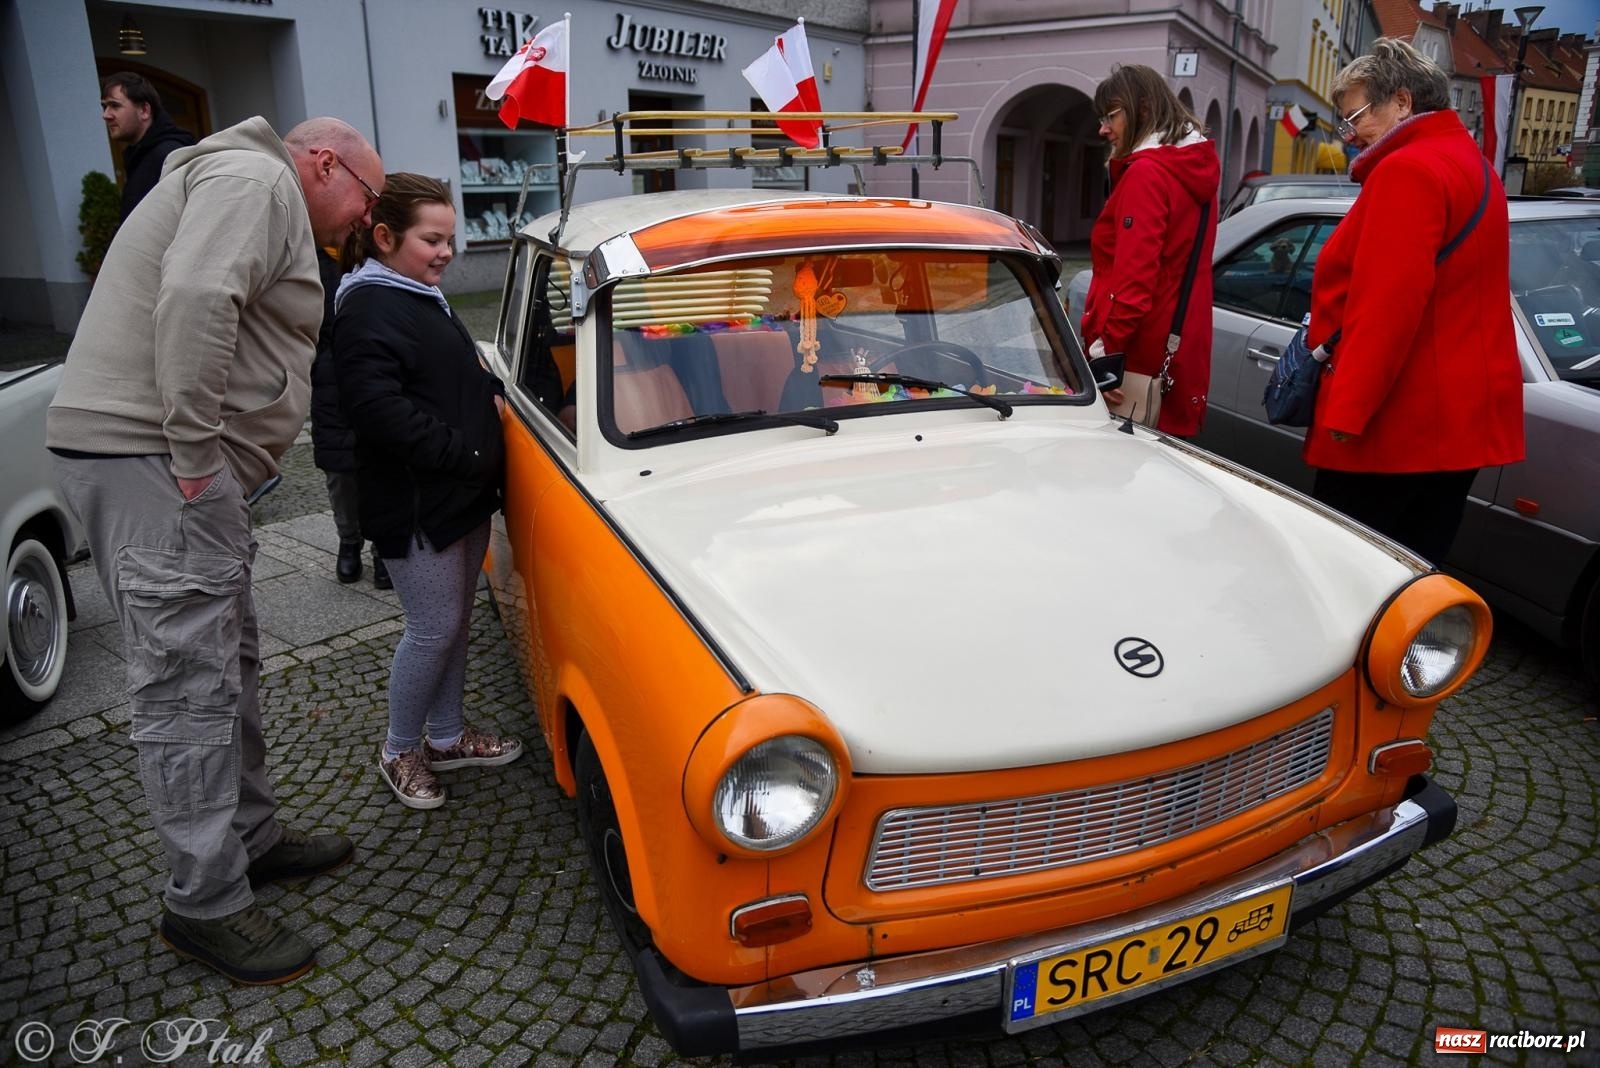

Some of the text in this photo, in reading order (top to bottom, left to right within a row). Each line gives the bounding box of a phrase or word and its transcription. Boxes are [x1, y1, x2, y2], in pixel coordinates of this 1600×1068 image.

[607, 13, 728, 61] JUBILER
[1013, 916, 1220, 1012] PL SRC 29
